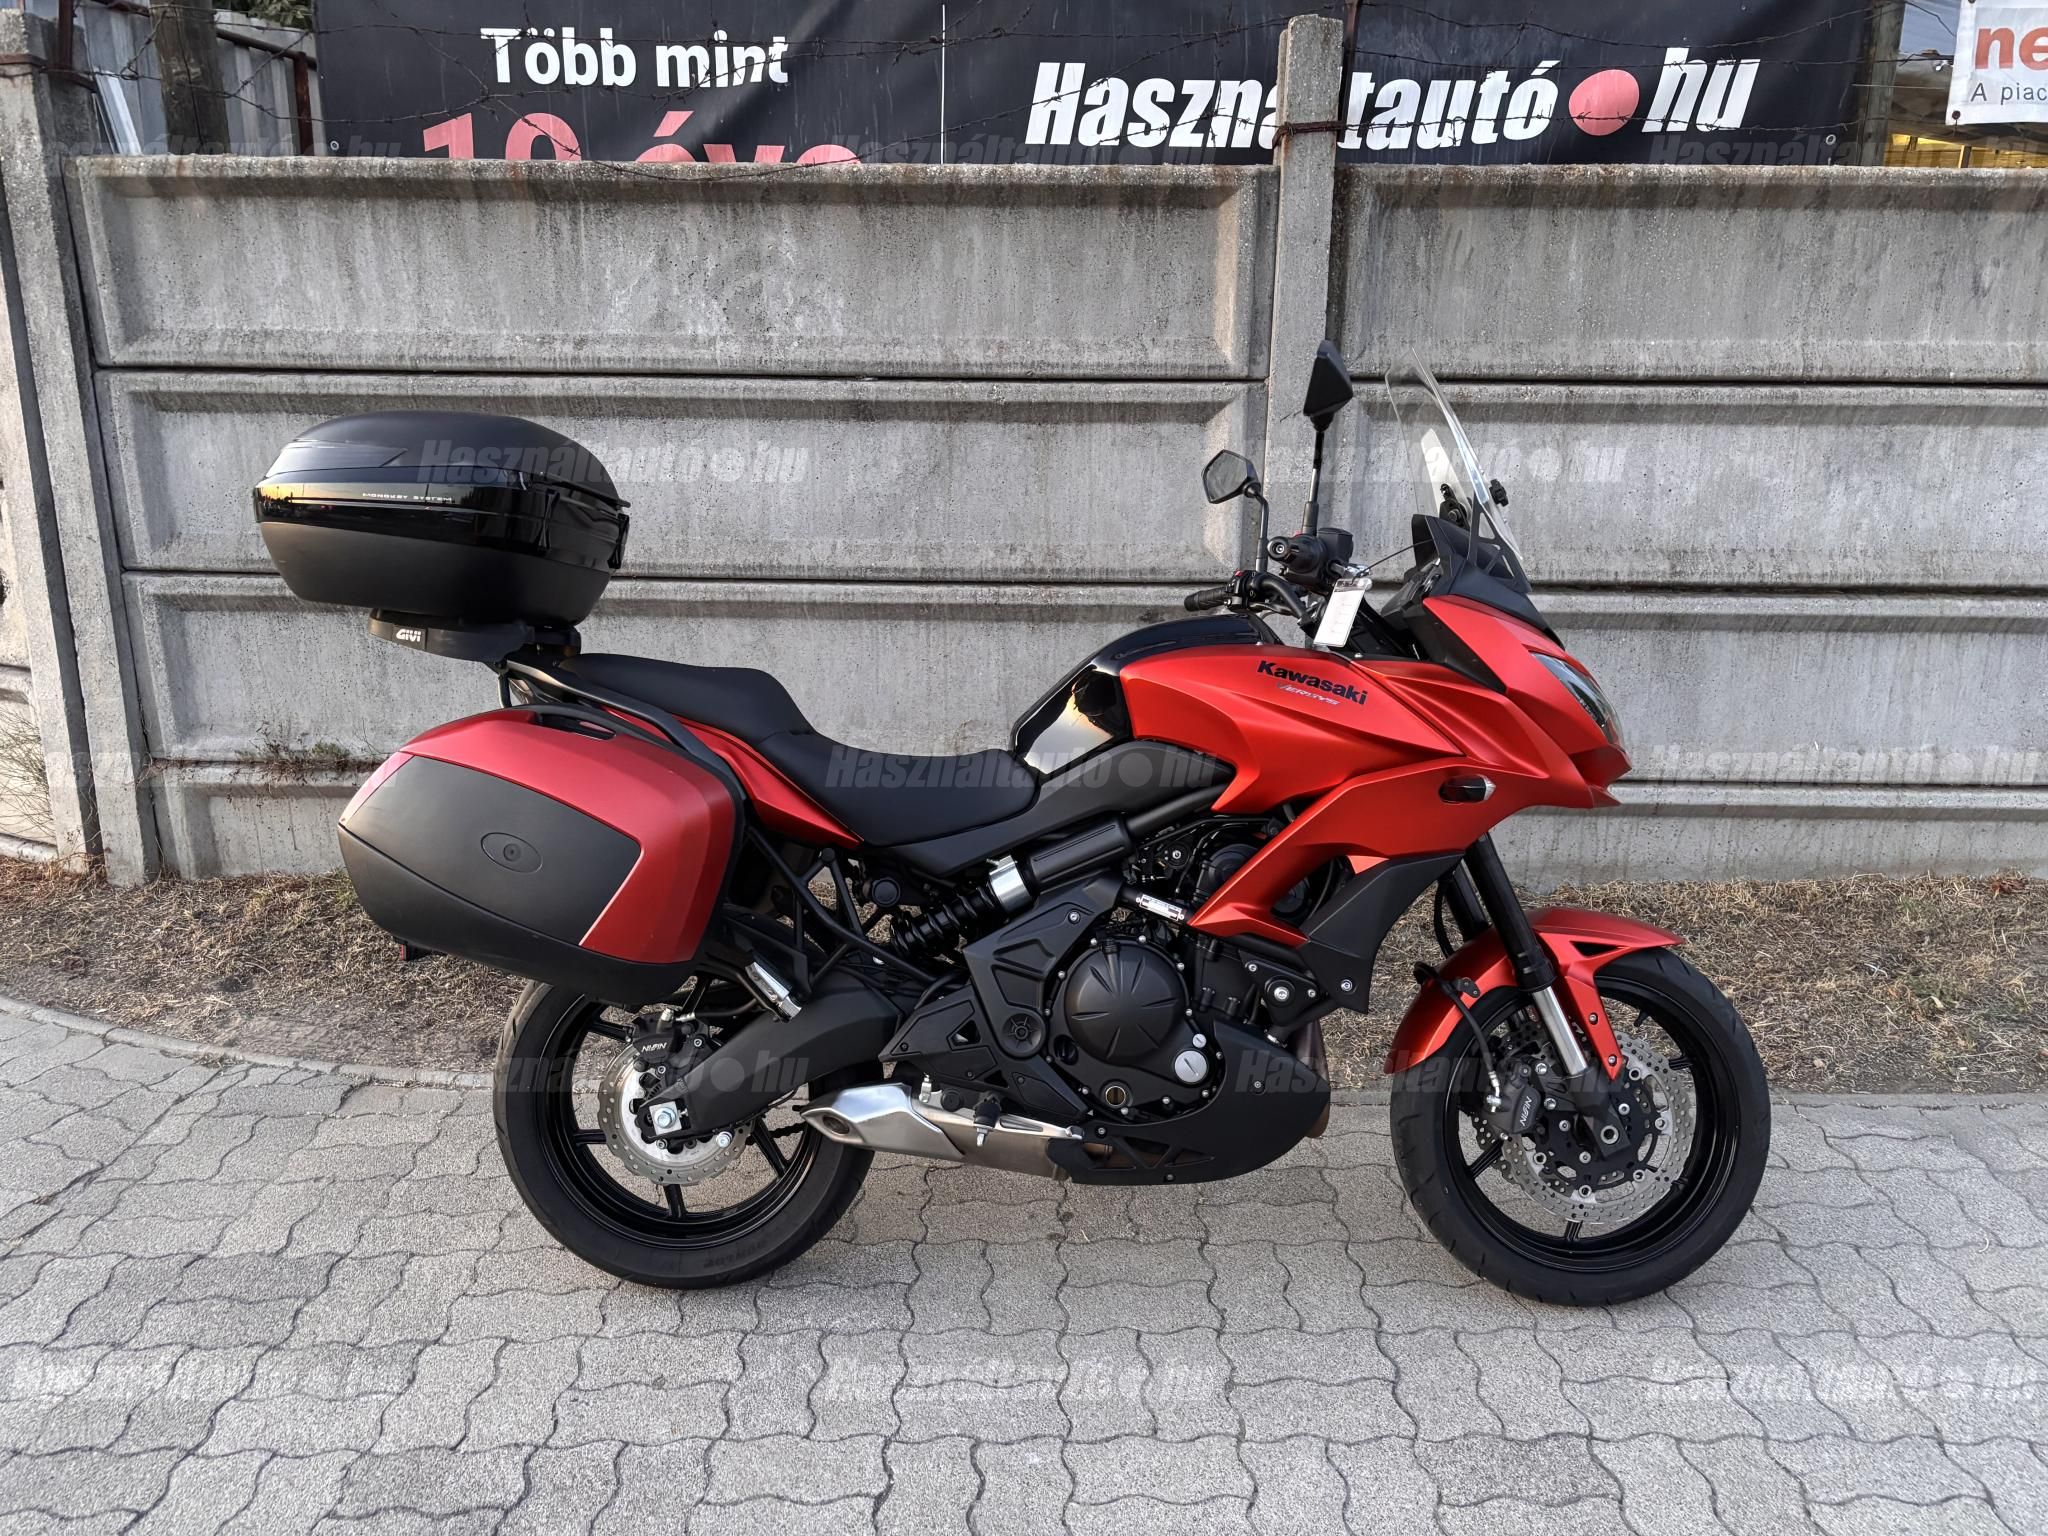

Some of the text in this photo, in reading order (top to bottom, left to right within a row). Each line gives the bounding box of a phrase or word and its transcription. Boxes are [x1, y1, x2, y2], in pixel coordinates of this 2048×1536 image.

[480, 26, 788, 88] Több mint
[1974, 27, 2048, 71] ne
[1970, 82, 2048, 106] A piac
[1257, 660, 1368, 705] Kawasaki
